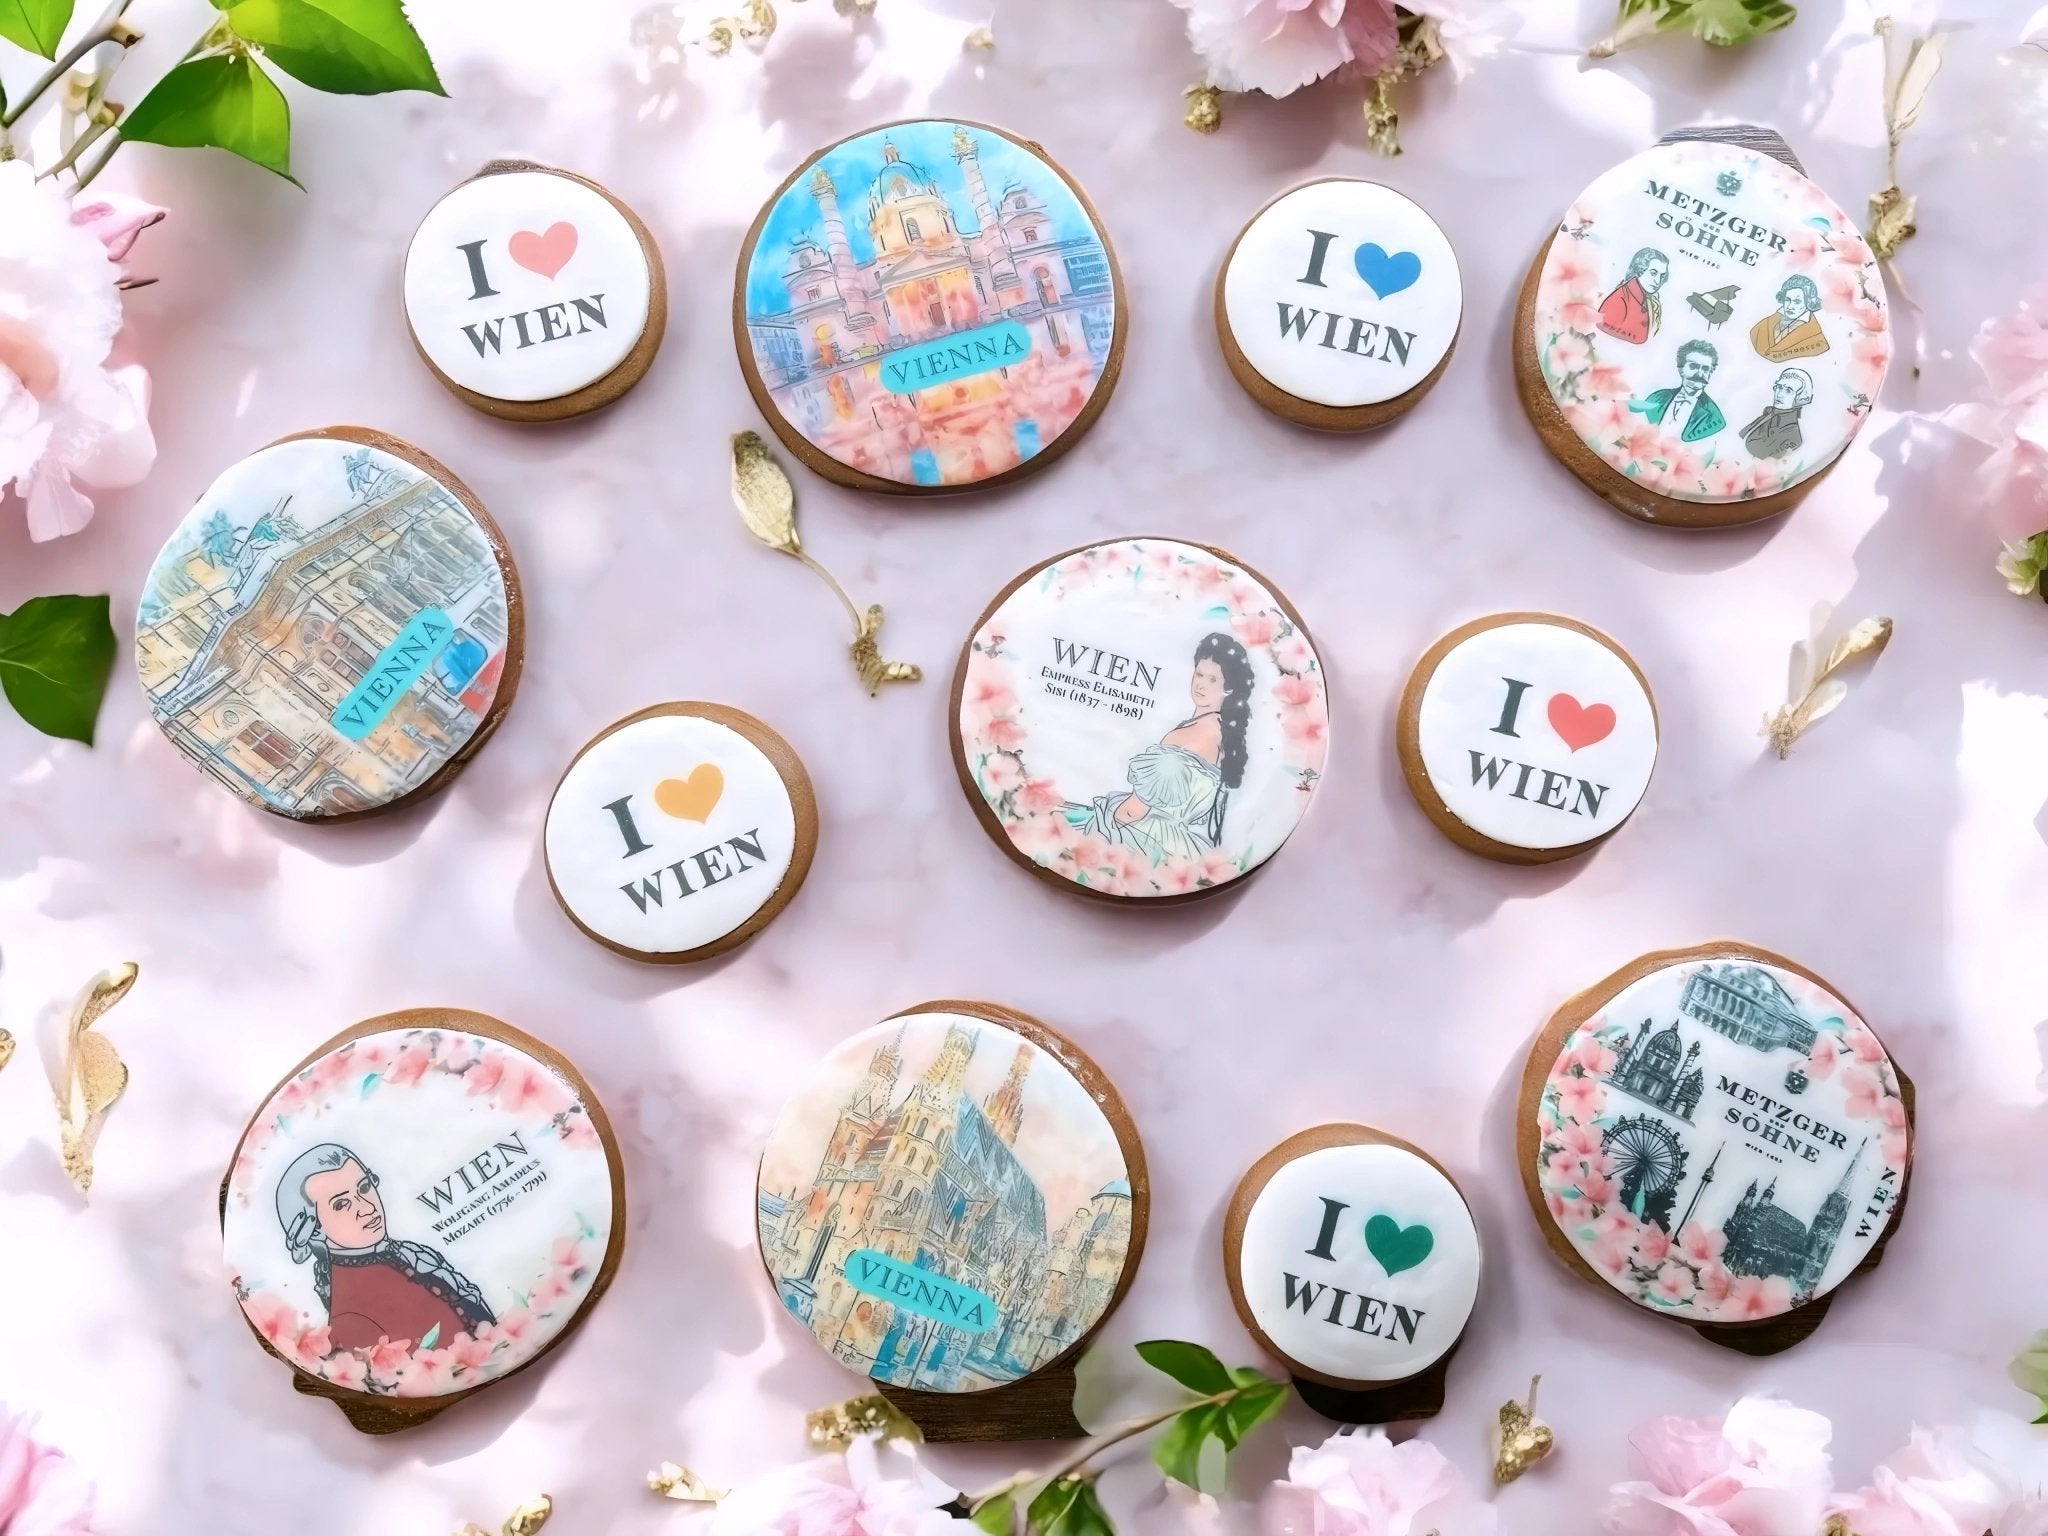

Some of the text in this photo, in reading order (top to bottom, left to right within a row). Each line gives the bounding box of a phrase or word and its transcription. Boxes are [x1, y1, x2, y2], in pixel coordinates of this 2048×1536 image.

[1644, 180, 1788, 253] METZGER
[1656, 212, 1760, 267] SÖHNE
[456, 239, 501, 301] I
[1296, 229, 1339, 288] I
[460, 293, 608, 359] WIEN
[889, 332, 1025, 385] VIENNA
[1276, 302, 1417, 368] WIEN
[341, 621, 447, 726] VIENNA
[1053, 637, 1163, 692] WIEN
[1489, 677, 1533, 738] I
[1468, 750, 1610, 819] WIEN
[602, 795, 653, 859] I
[618, 828, 767, 915] WIEN
[1716, 1075, 1848, 1151] METZGER
[416, 1130, 528, 1214] WIEN
[1855, 1165, 1897, 1238] WIEN
[1305, 1196, 1351, 1262] I
[860, 1256, 983, 1326] VIENNA
[1283, 1272, 1426, 1345] WIEN
